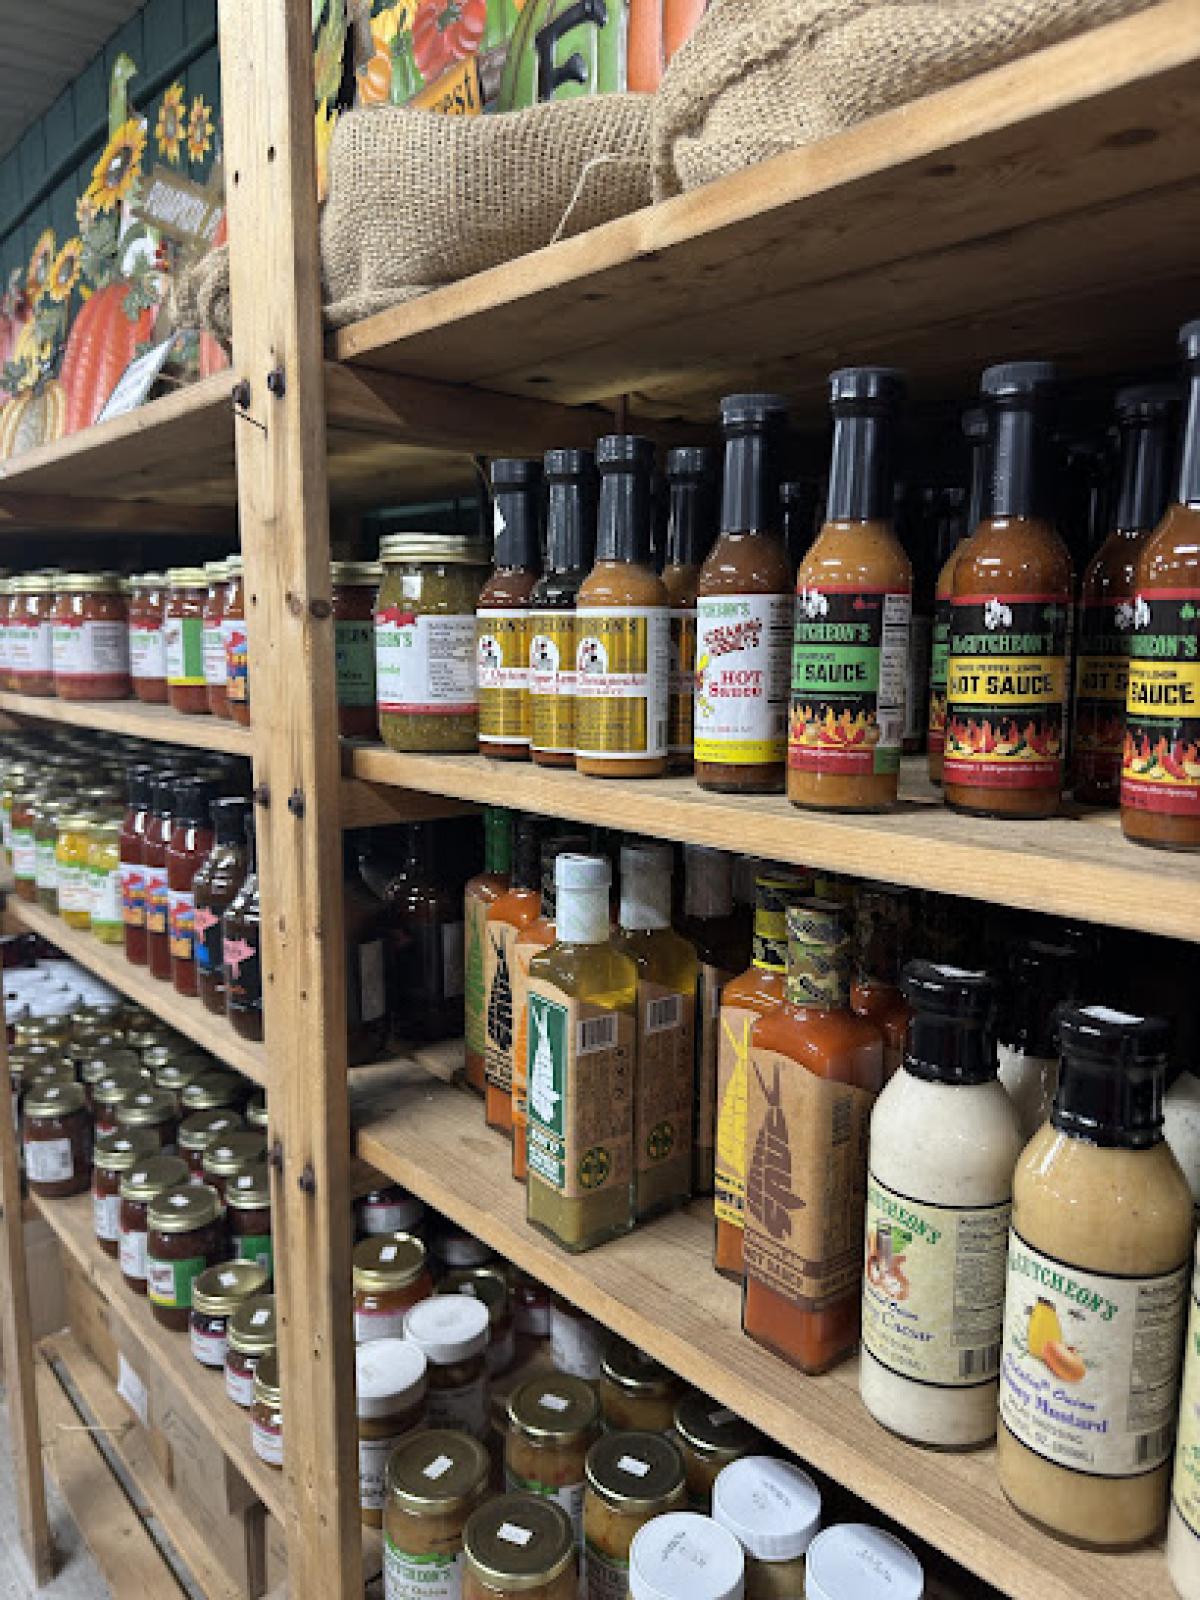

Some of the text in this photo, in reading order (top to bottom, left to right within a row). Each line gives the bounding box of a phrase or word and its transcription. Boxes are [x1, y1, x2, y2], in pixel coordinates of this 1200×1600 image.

[721, 670, 763, 685] HOT
[805, 661, 868, 683] SAUCE
[987, 673, 1053, 695] SAUCE
[1131, 681, 1196, 704] SAUCE
[1035, 1396, 1108, 1433] Mustard
